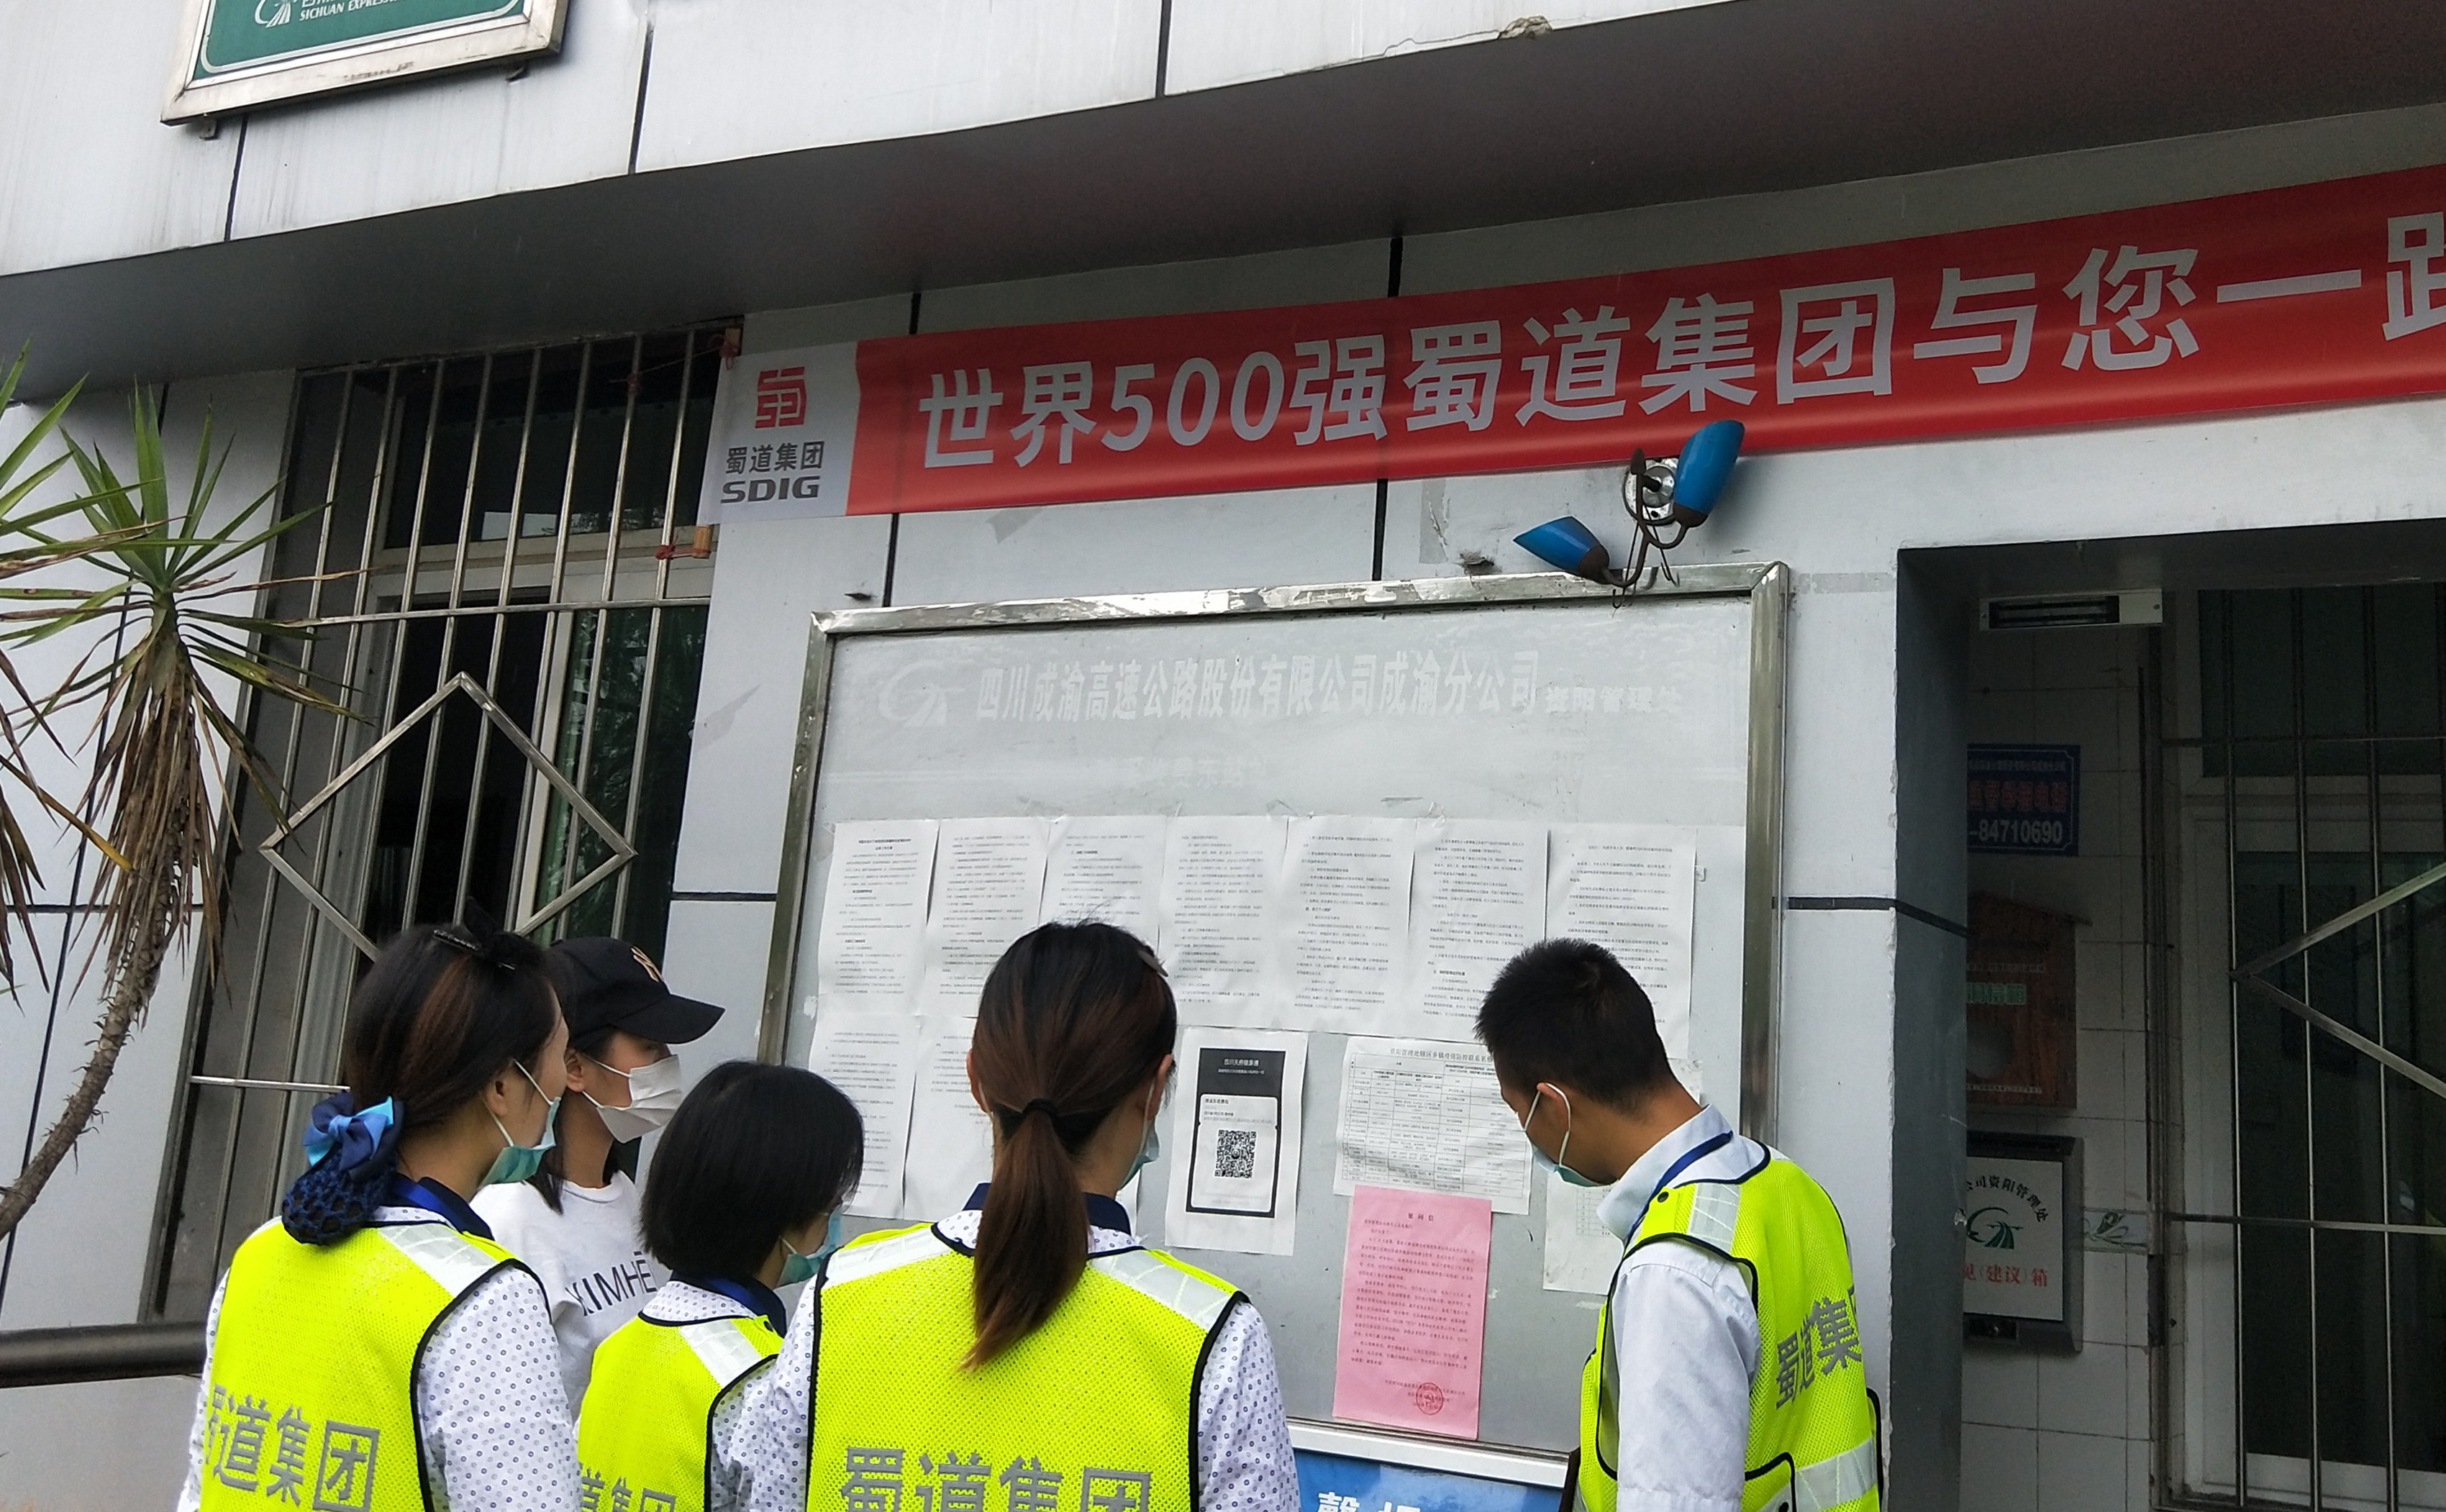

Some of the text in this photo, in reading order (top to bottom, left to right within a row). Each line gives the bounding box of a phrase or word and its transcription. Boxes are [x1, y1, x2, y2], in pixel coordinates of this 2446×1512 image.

[299, 2, 344, 22] SICHUAN
[348, 0, 398, 11] EXPRE
[725, 440, 826, 475] 蜀道集团
[720, 475, 820, 504] SDIG
[1776, 1285, 1862, 1410] 蜀道集
